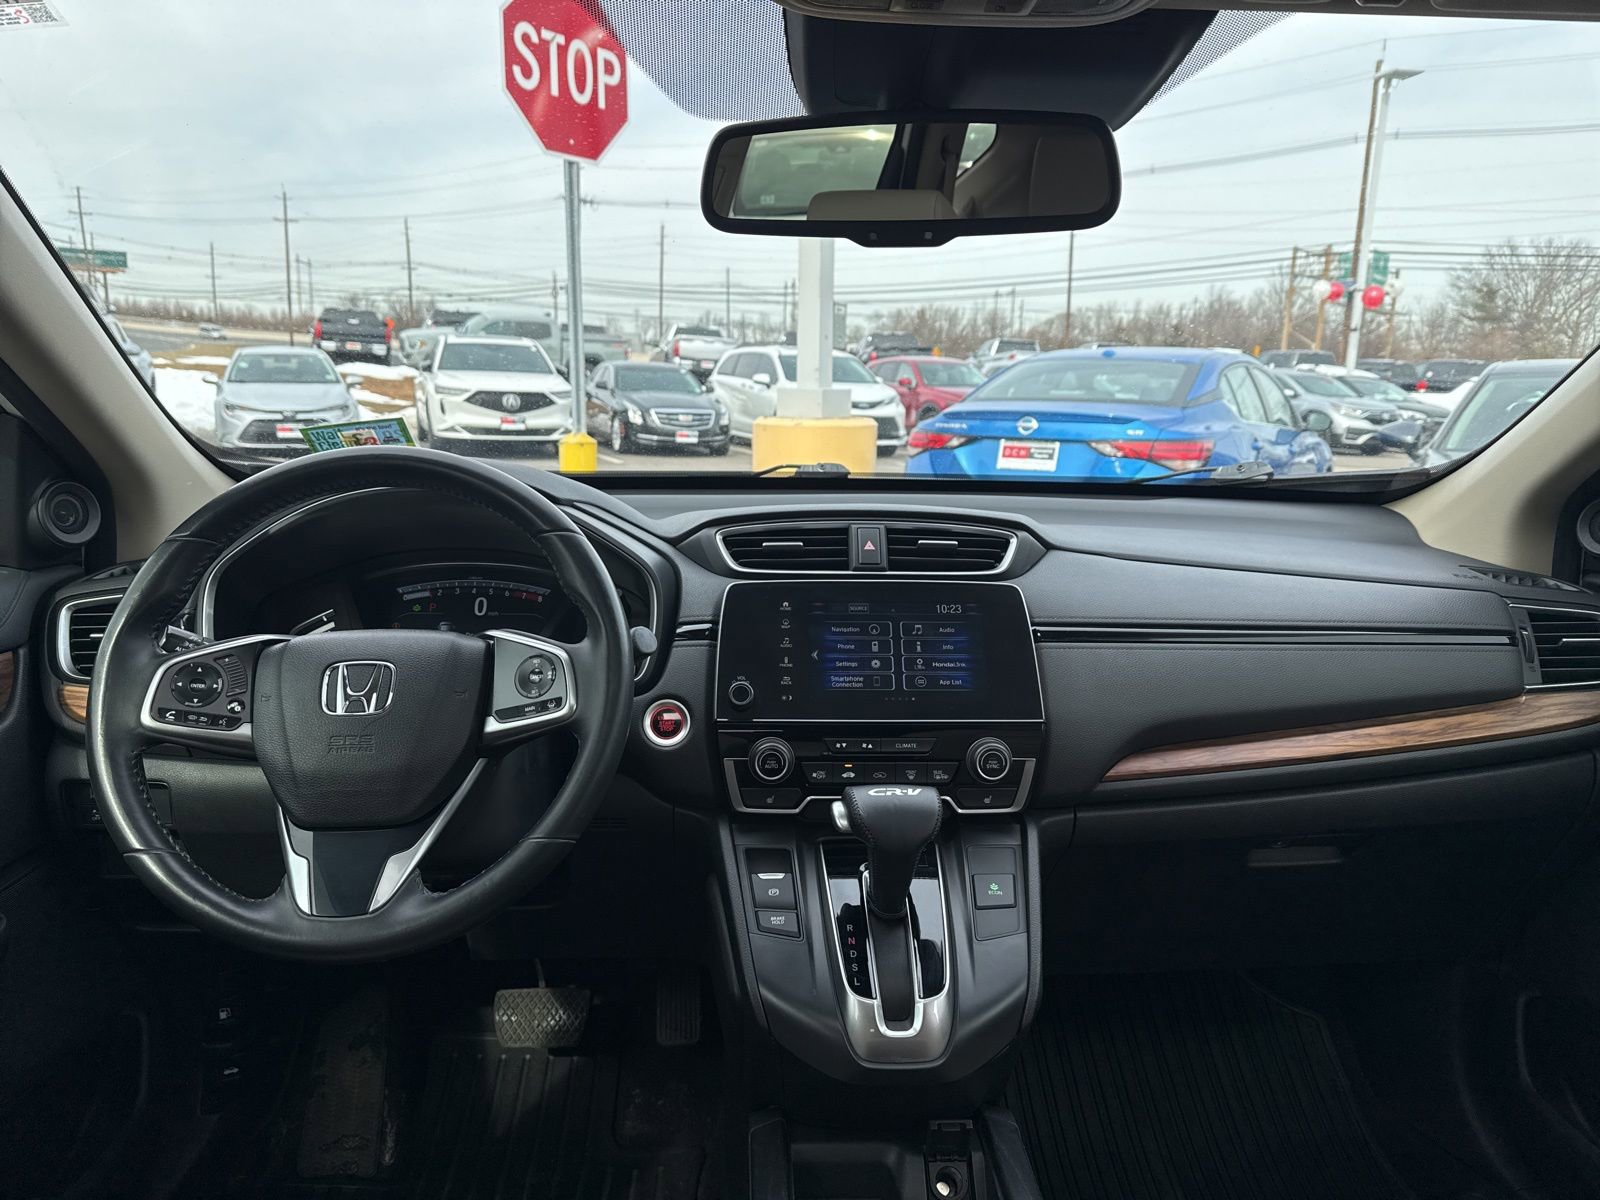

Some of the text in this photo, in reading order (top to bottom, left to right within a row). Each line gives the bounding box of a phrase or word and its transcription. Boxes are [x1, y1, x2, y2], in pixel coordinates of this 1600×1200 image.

[512, 21, 621, 110] STOP
[474, 597, 488, 616] 0
[936, 604, 962, 614] 10:23
[867, 787, 922, 796] CR-V
[846, 924, 853, 932] R
[848, 937, 855, 945] N
[850, 950, 857, 958] D
[852, 963, 858, 972] S
[854, 977, 860, 986] L
